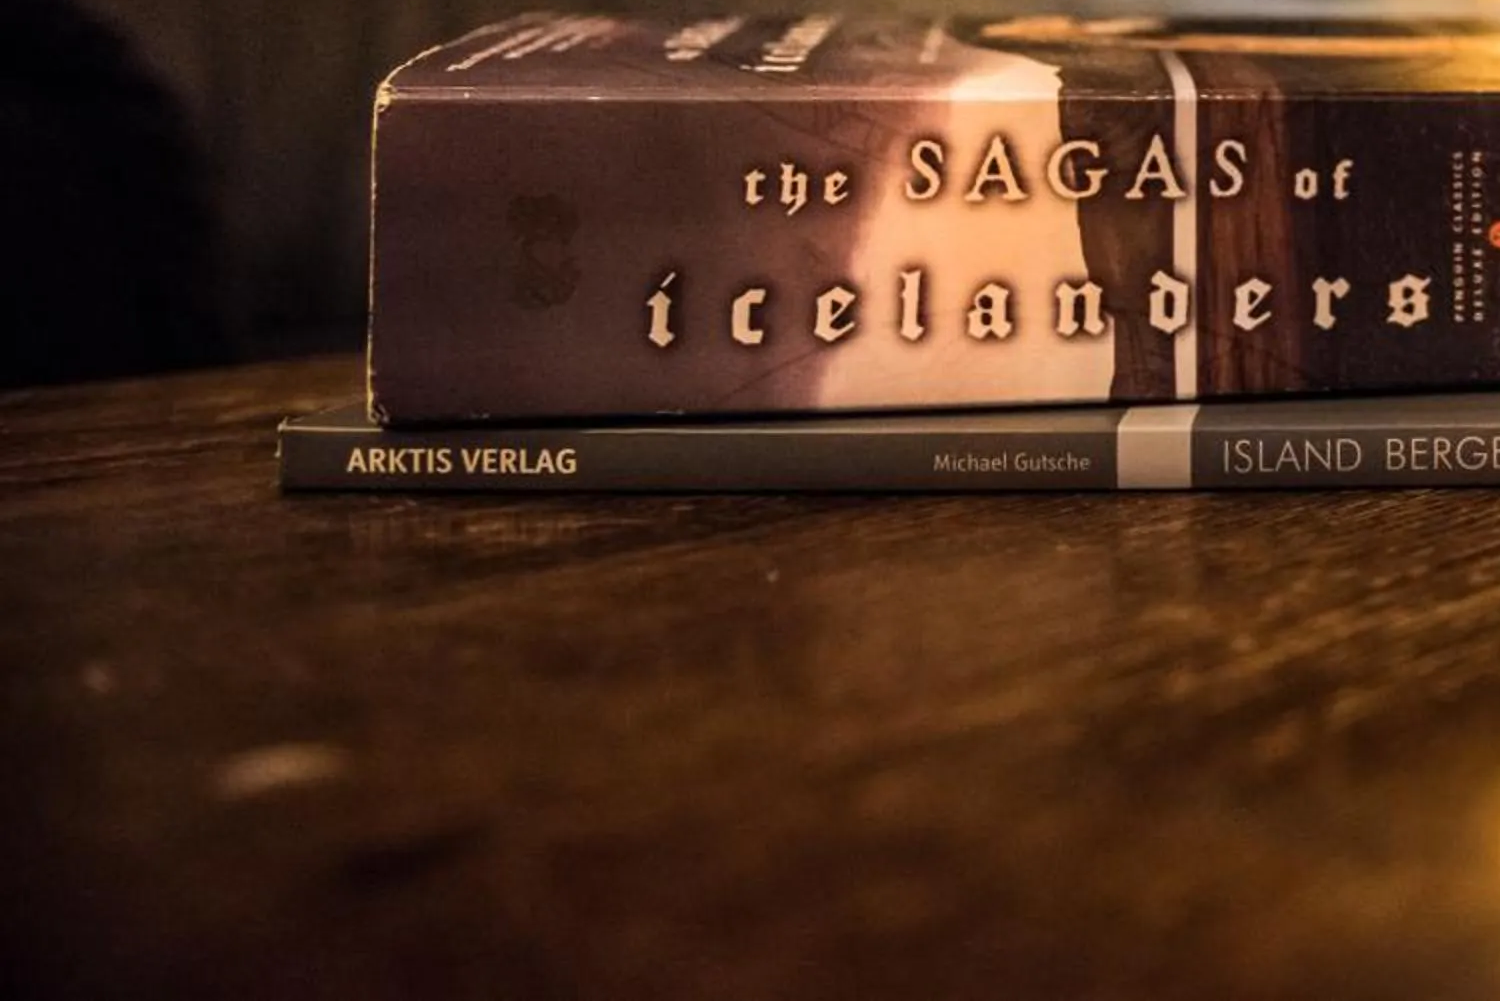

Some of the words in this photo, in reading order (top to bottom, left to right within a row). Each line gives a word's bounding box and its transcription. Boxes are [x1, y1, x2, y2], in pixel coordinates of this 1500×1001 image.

[744, 162, 849, 216] the
[904, 135, 1249, 201] SAGAS
[1293, 159, 1354, 201] of
[1471, 151, 1484, 235] EDITION
[346, 447, 452, 475] ARKTIS
[462, 447, 577, 475] VERLAG
[934, 452, 1007, 472] Michael
[1014, 452, 1091, 472] Gutsche
[1222, 438, 1362, 474] ISLAND
